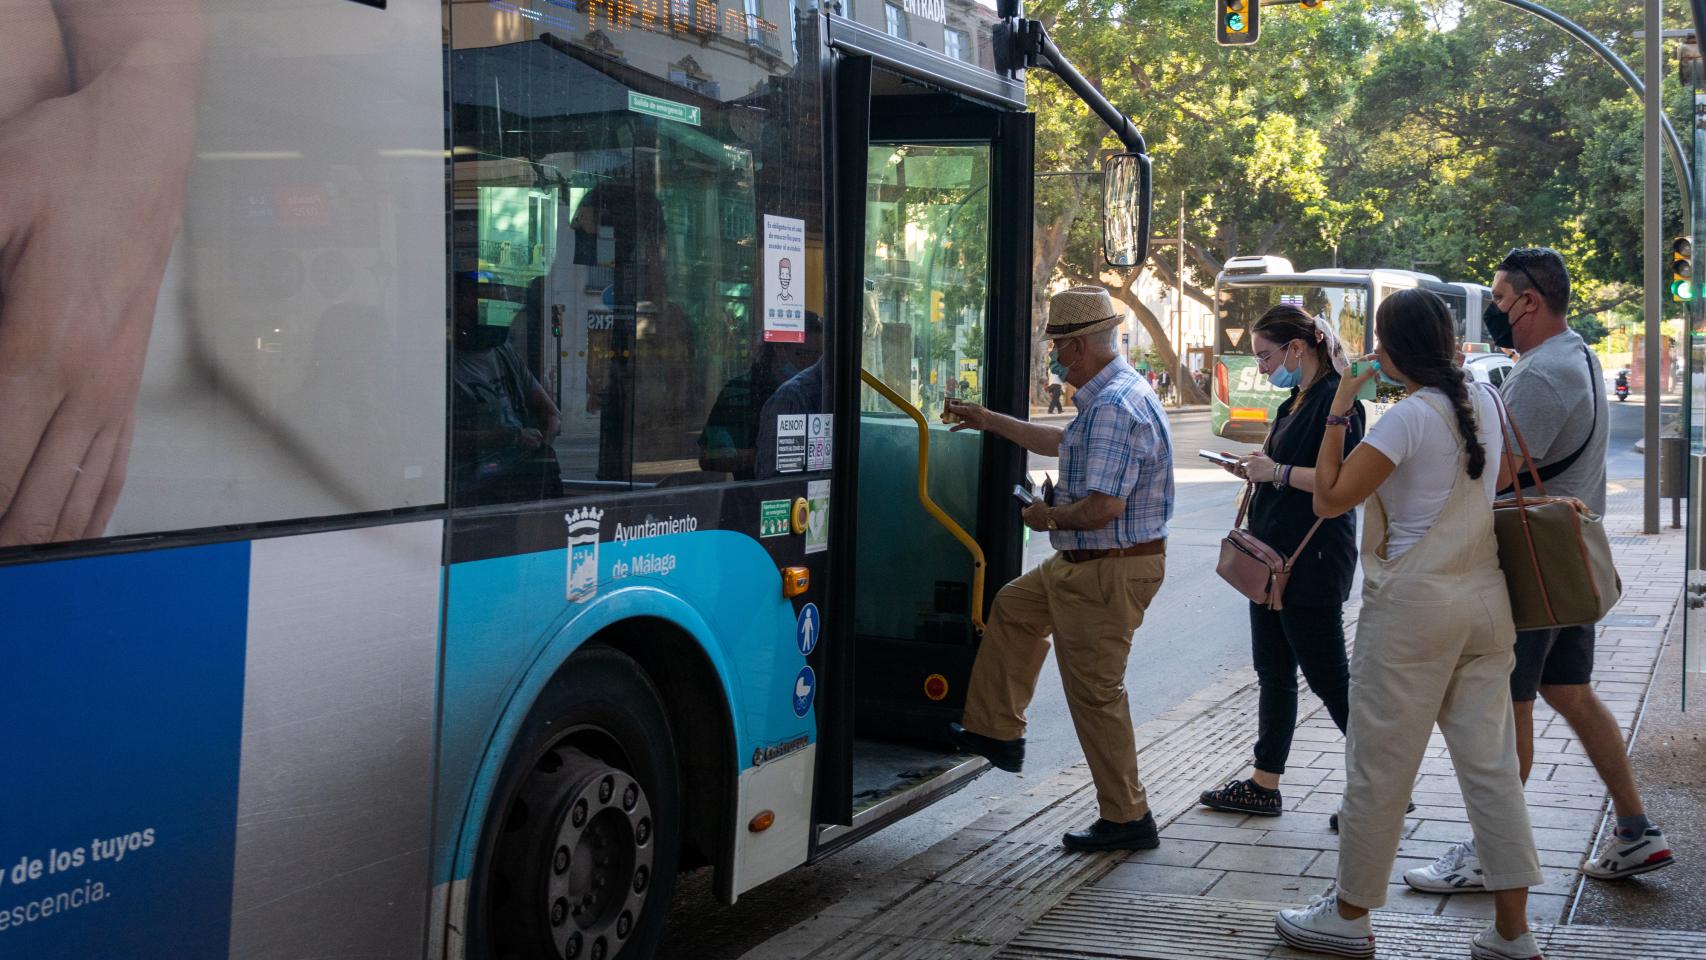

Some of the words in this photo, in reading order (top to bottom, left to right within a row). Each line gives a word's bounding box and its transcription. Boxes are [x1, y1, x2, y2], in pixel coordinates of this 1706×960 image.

[780, 419, 804, 431] AENOR
[613, 514, 698, 547] Ayuntamiento
[612, 559, 629, 579] de
[632, 553, 676, 576] Málaga
[11, 856, 43, 885] de
[49, 848, 86, 874] los
[91, 827, 155, 862] tuyos
